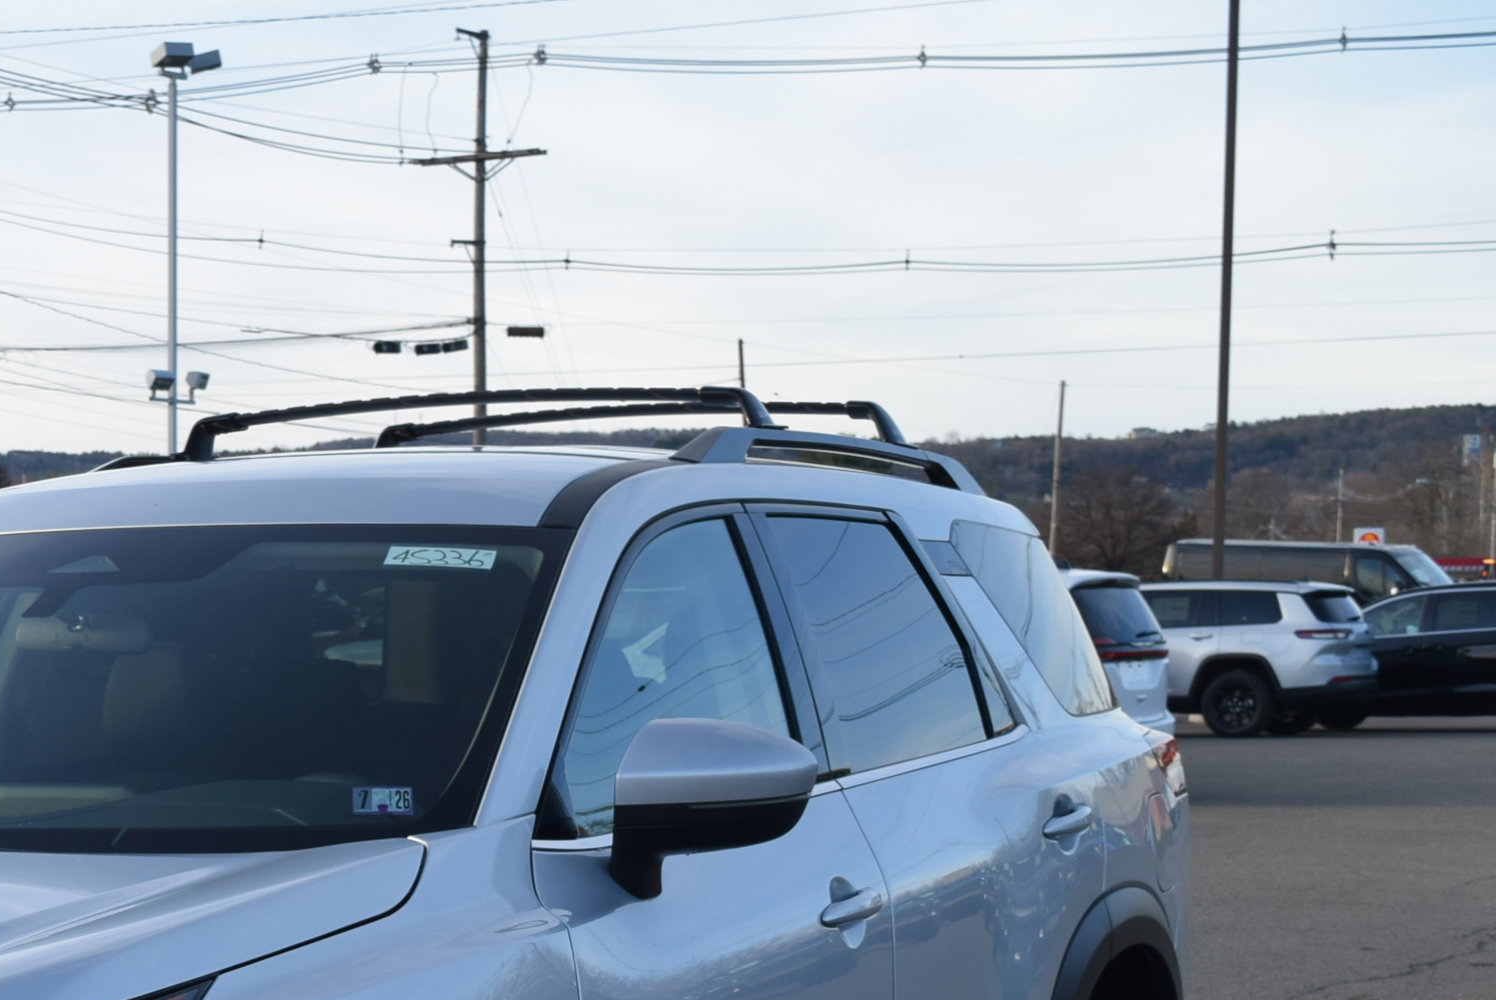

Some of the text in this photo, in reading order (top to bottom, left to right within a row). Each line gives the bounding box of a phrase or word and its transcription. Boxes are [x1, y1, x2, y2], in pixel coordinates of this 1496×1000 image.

[392, 549, 484, 568] 45336
[358, 789, 410, 810] 7 26
